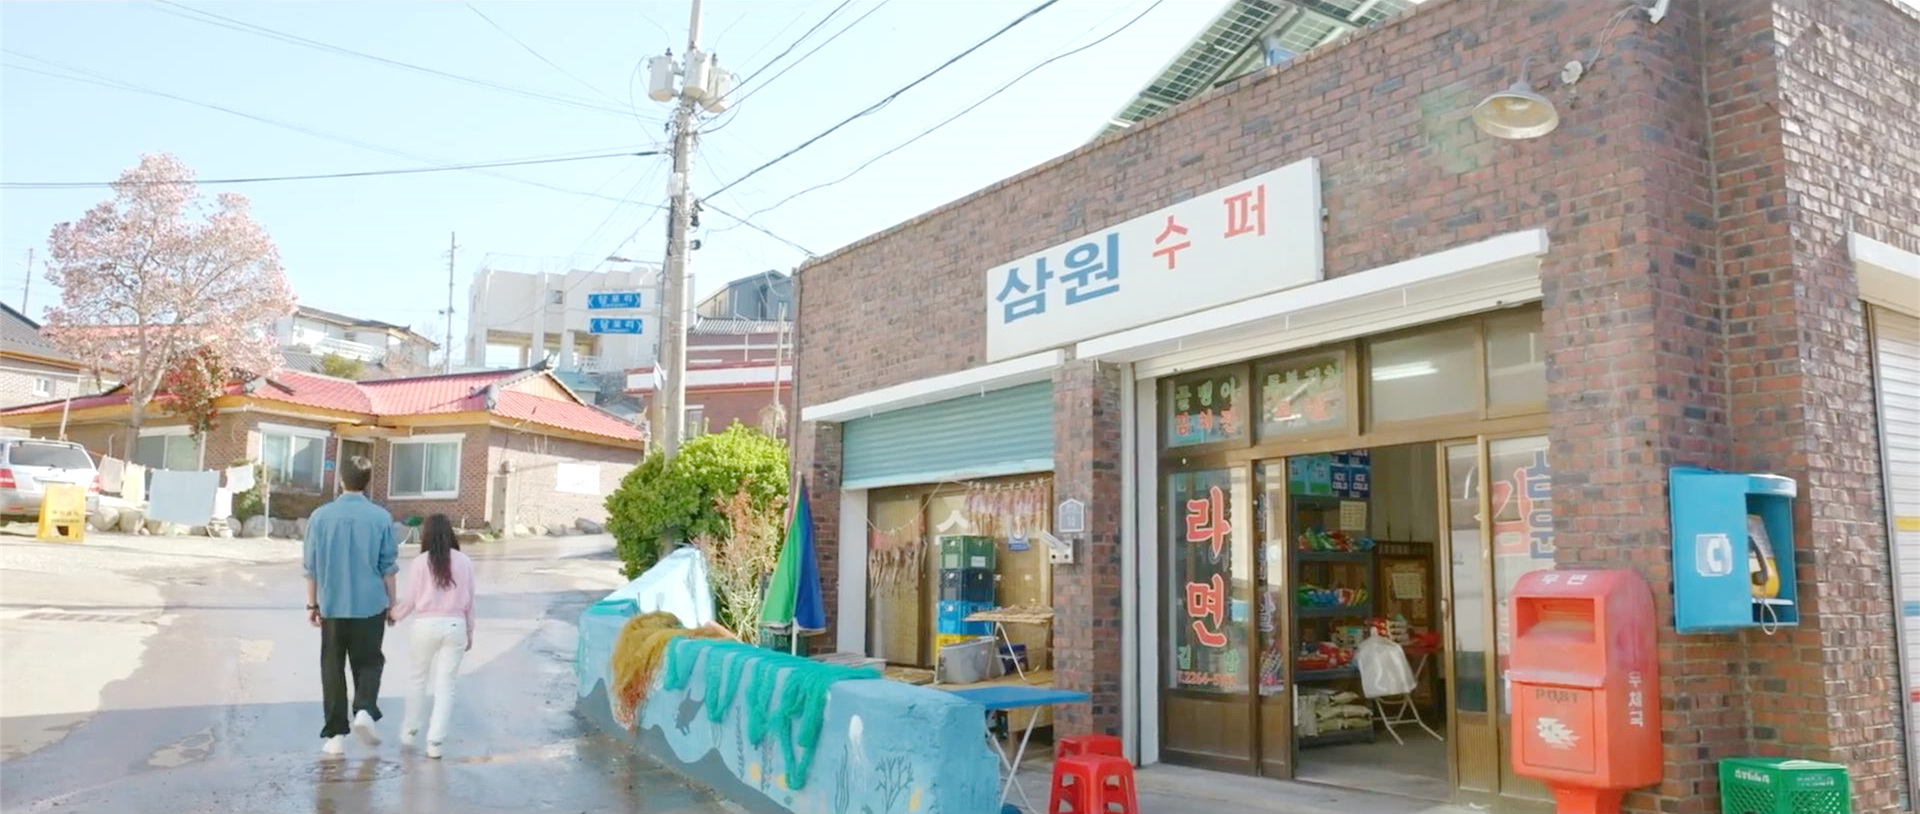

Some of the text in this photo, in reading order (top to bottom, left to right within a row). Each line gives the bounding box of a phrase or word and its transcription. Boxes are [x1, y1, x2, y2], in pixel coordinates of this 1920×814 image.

[996, 233, 1119, 323] 삼원
[1185, 485, 1232, 648] 라면
[1627, 671, 1644, 728] 우체국
